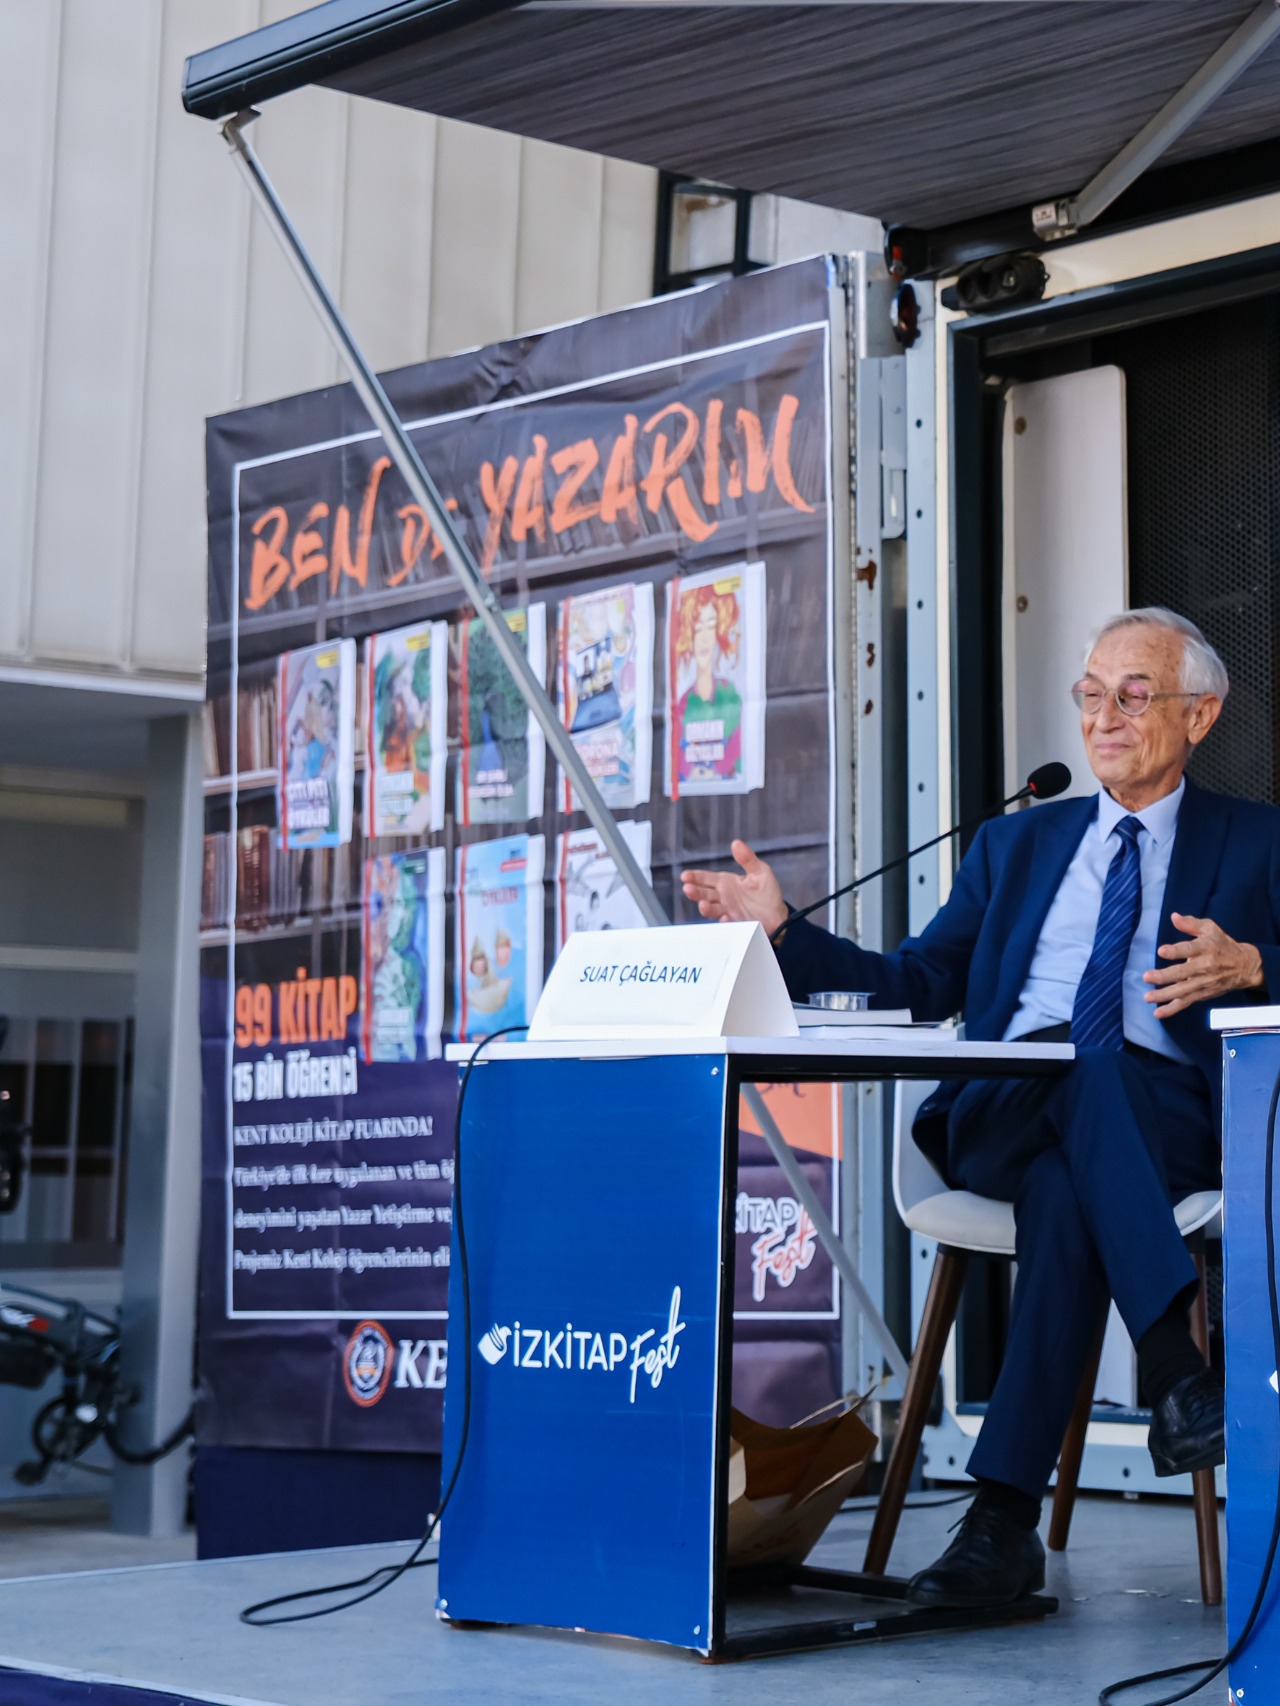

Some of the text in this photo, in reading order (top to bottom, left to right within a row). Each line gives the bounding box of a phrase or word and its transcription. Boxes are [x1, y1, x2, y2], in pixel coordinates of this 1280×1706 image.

[245, 456, 392, 611] BEN
[236, 966, 358, 1048] 99 KİTAP
[580, 960, 702, 986] SUAT ÇAĞLAYAN
[234, 1046, 358, 1102] 15 BİN ÖĞRENCİ
[234, 1125, 268, 1146] KENT
[314, 1116, 354, 1143] KİTAP
[514, 1285, 687, 1404] İZKİTAP Fest
